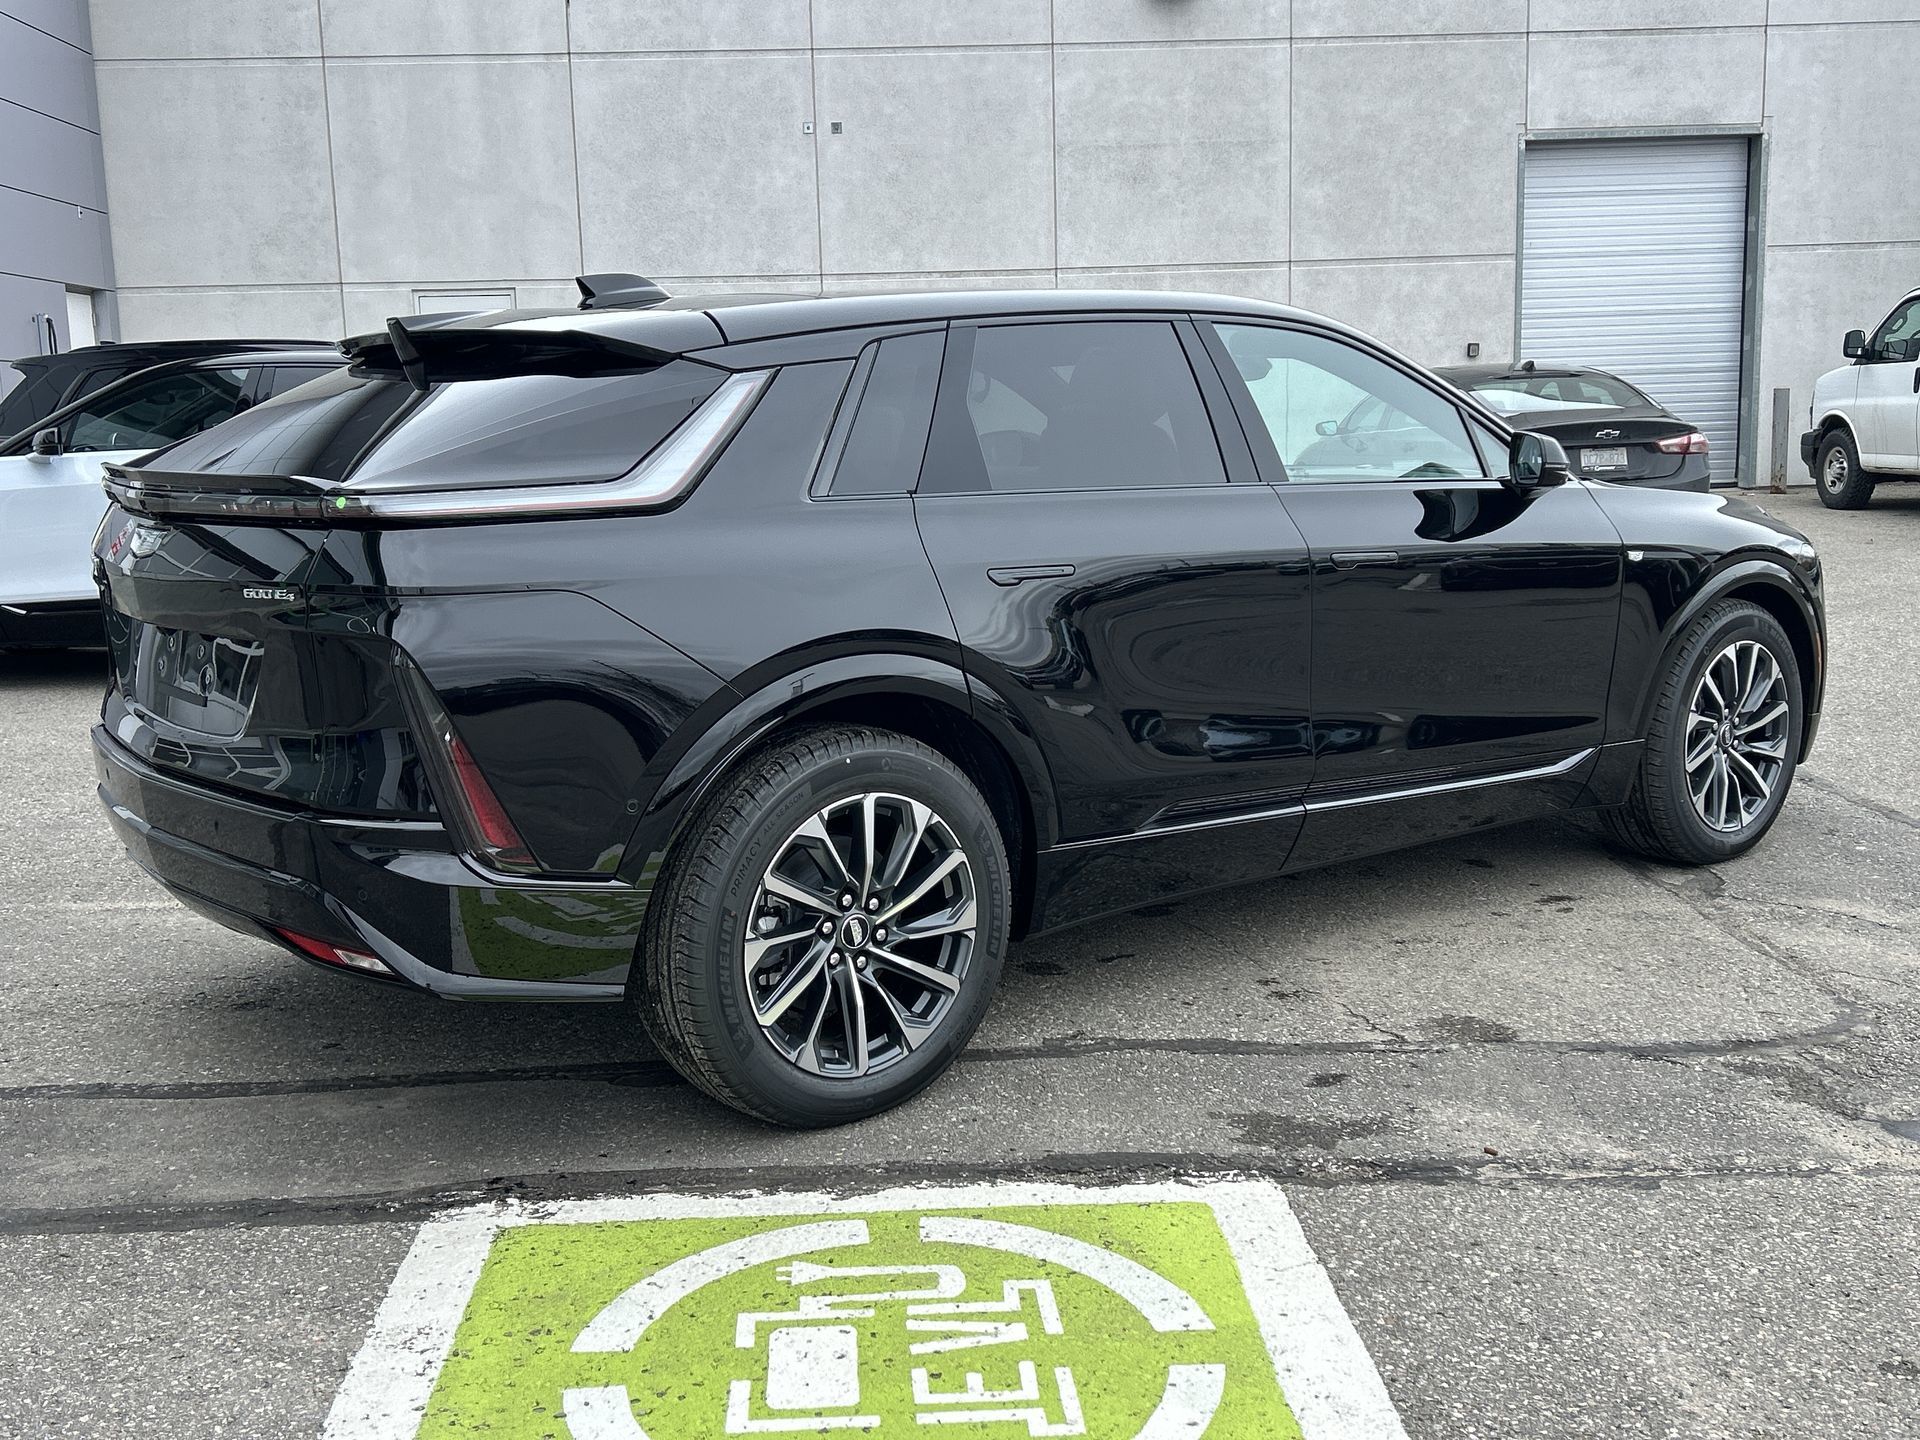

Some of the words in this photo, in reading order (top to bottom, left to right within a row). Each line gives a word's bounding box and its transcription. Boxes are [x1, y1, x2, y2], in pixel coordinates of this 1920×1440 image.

[243, 588, 272, 599] 600
[731, 838, 761, 896] PRIMACY
[763, 821, 776, 835] ALL
[776, 792, 804, 817] SEASON
[986, 856, 1001, 957] MICHELIN
[719, 914, 740, 1025] MICHELIN
[905, 1319, 1040, 1405] EV
